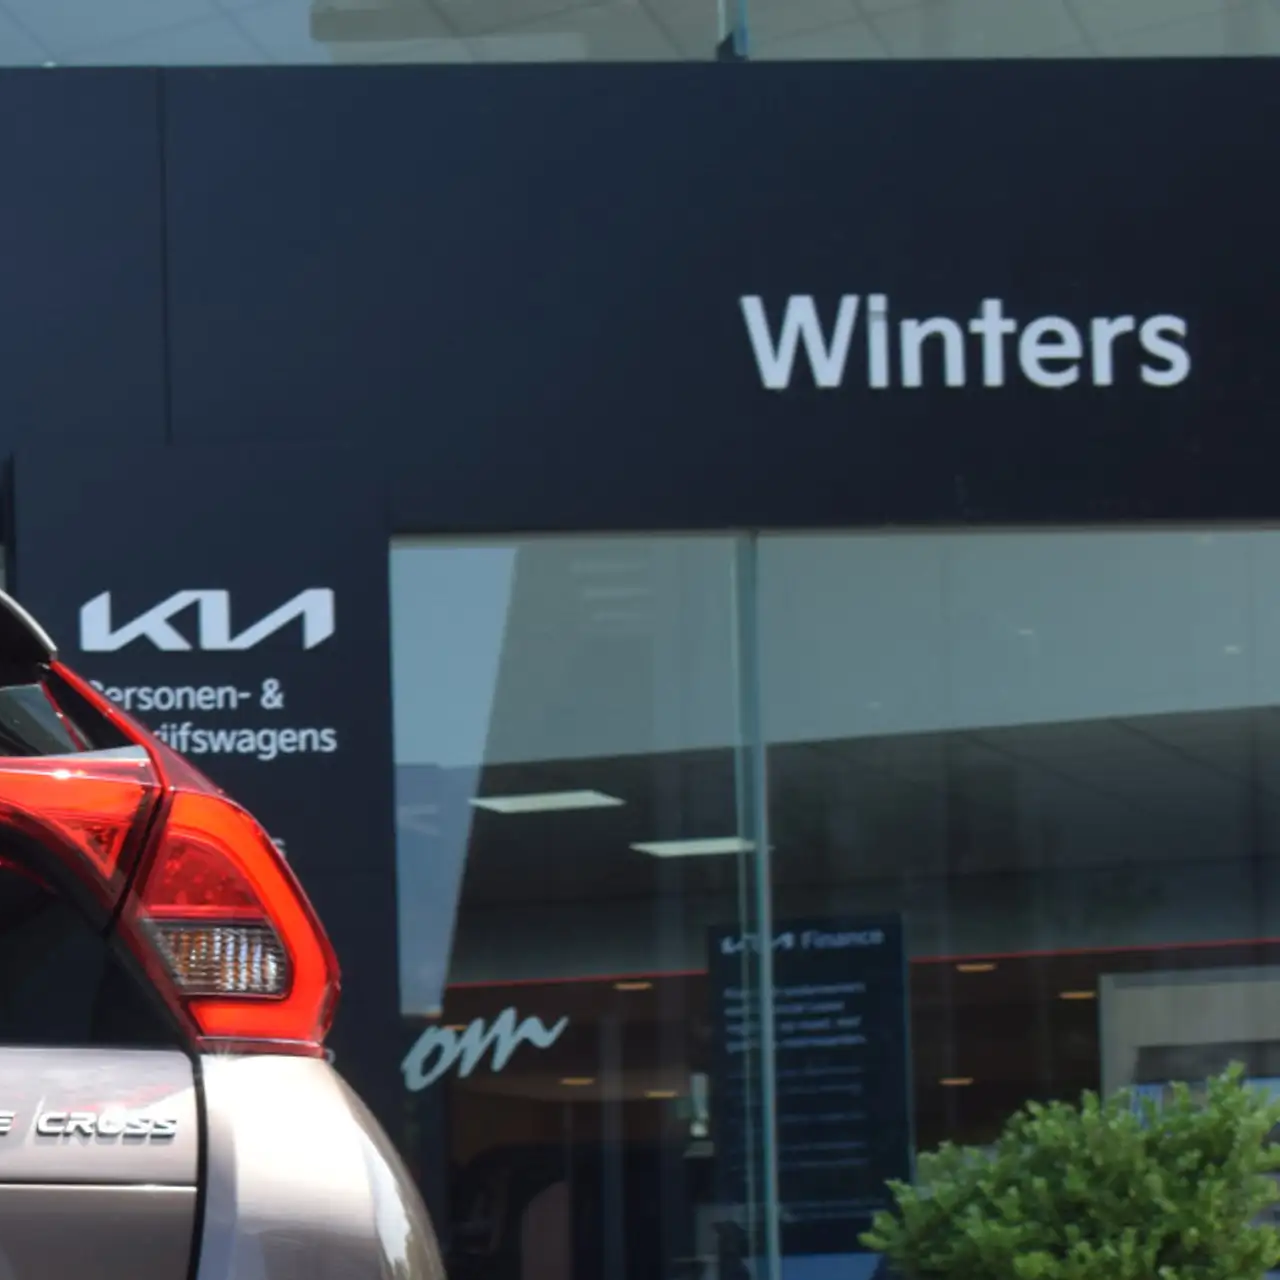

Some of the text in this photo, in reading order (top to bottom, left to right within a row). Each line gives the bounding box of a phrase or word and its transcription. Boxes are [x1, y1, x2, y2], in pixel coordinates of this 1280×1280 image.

[740, 294, 1191, 389] Winters
[79, 587, 335, 652] KIA
[260, 678, 284, 710] &
[35, 1109, 178, 1138] CROSS
